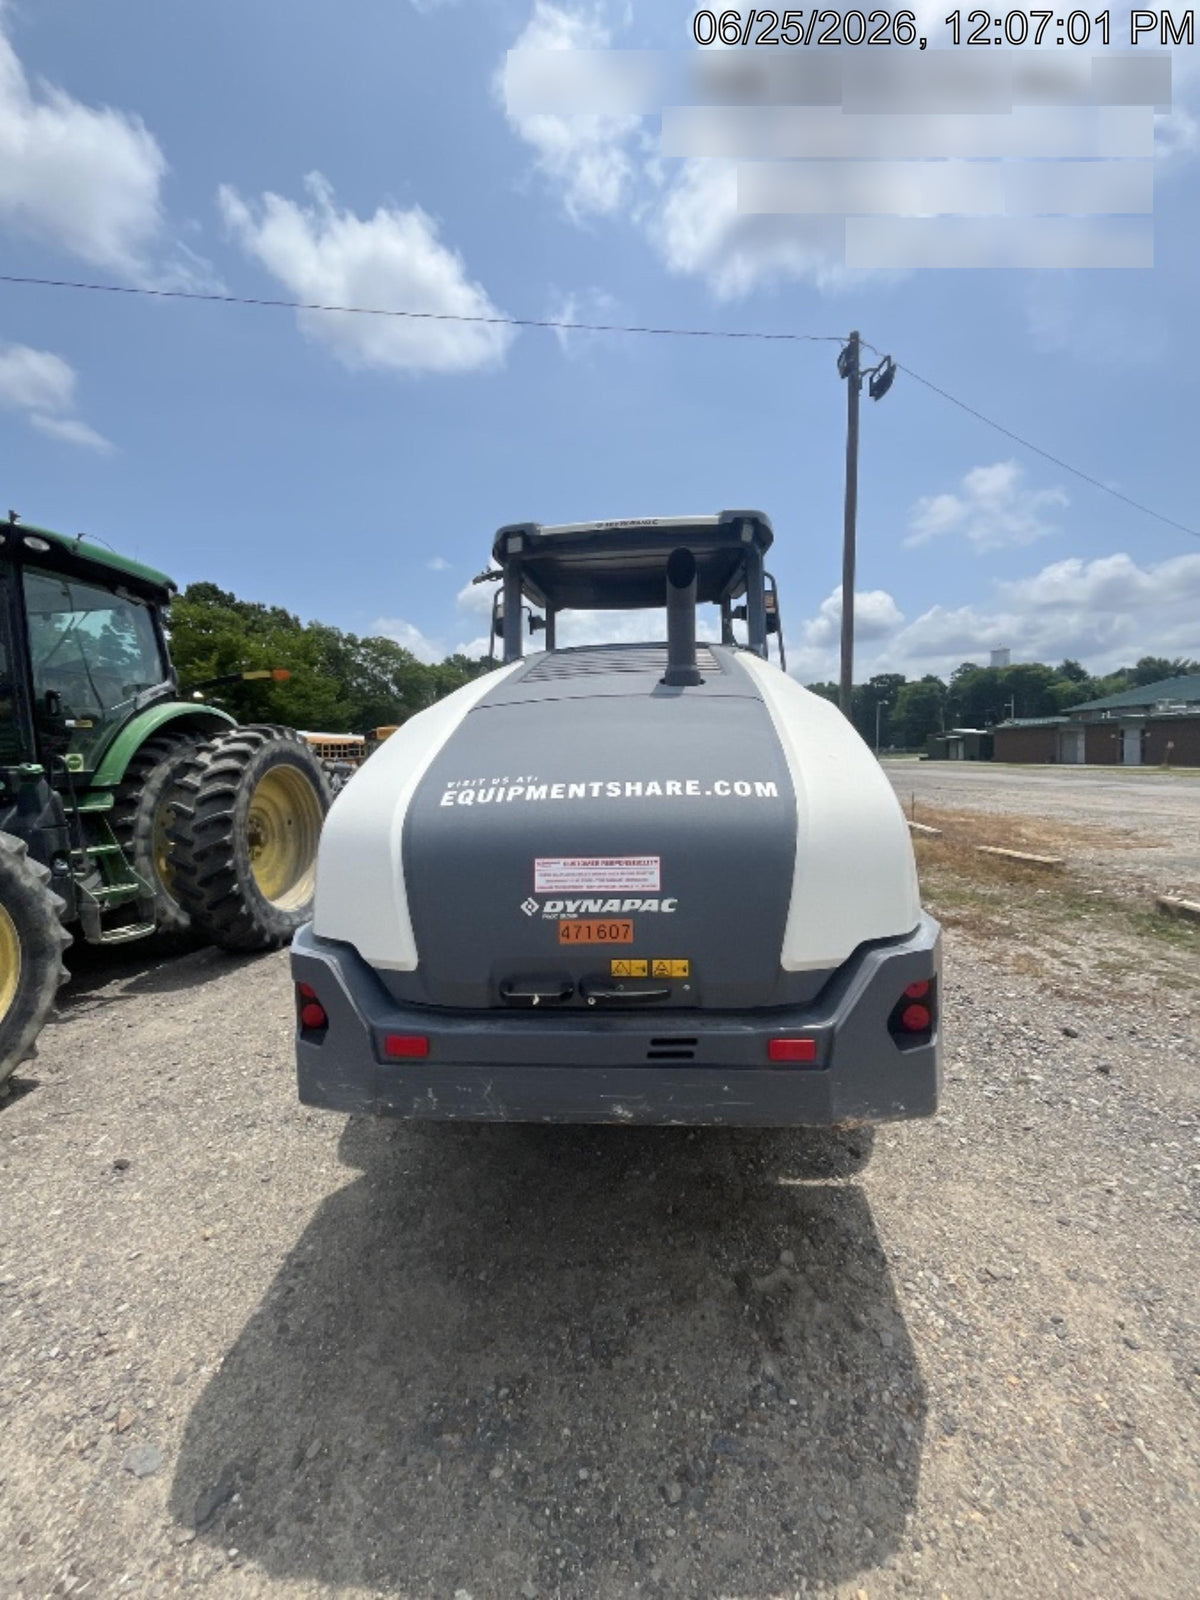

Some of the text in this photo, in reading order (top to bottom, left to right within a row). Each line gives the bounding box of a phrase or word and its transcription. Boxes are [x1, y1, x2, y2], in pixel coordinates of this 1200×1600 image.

[447, 778, 486, 789] VISIT
[492, 776, 509, 785] US
[440, 779, 779, 806] EQUIPMENTSHARE.COM
[543, 898, 678, 914] DYNAPAC
[561, 924, 631, 941] 471607
